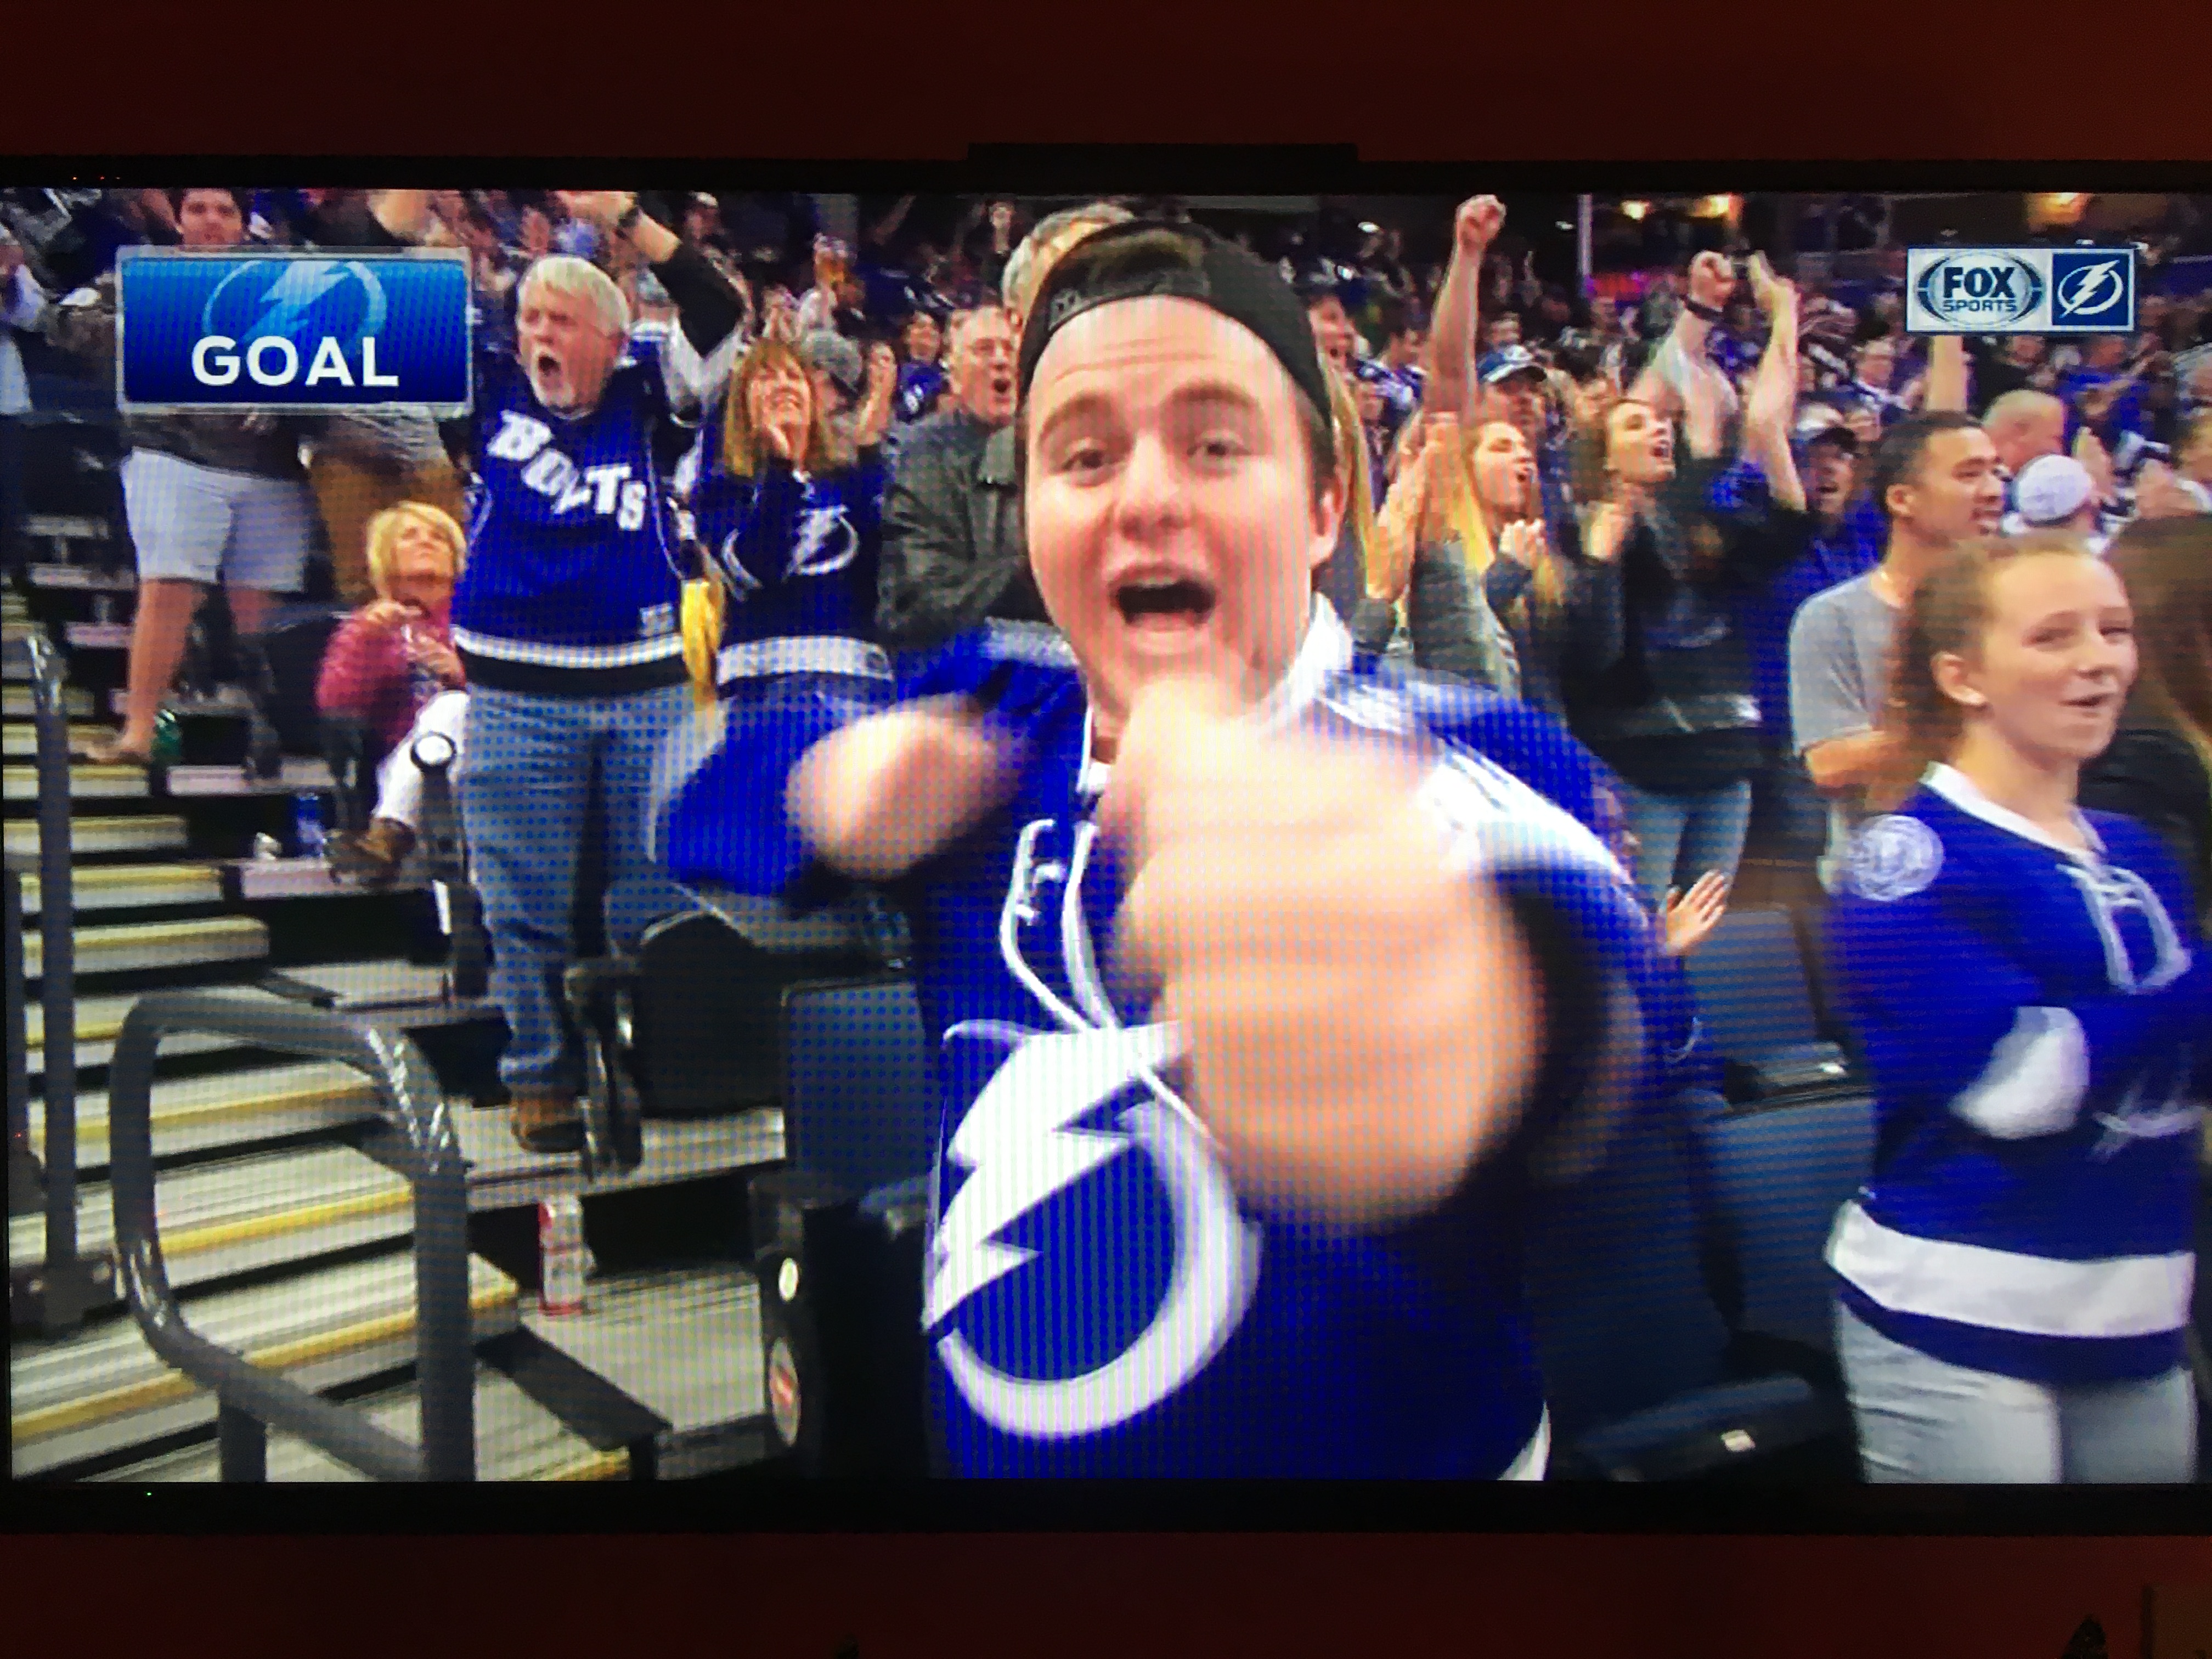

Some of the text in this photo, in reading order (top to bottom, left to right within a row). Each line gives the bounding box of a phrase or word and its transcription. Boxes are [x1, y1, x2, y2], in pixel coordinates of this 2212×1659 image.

[1943, 267, 2016, 298] FOX
[1943, 300, 2017, 312] SPORTS
[191, 335, 399, 386] GOAL
[487, 410, 648, 531] BOLTS
